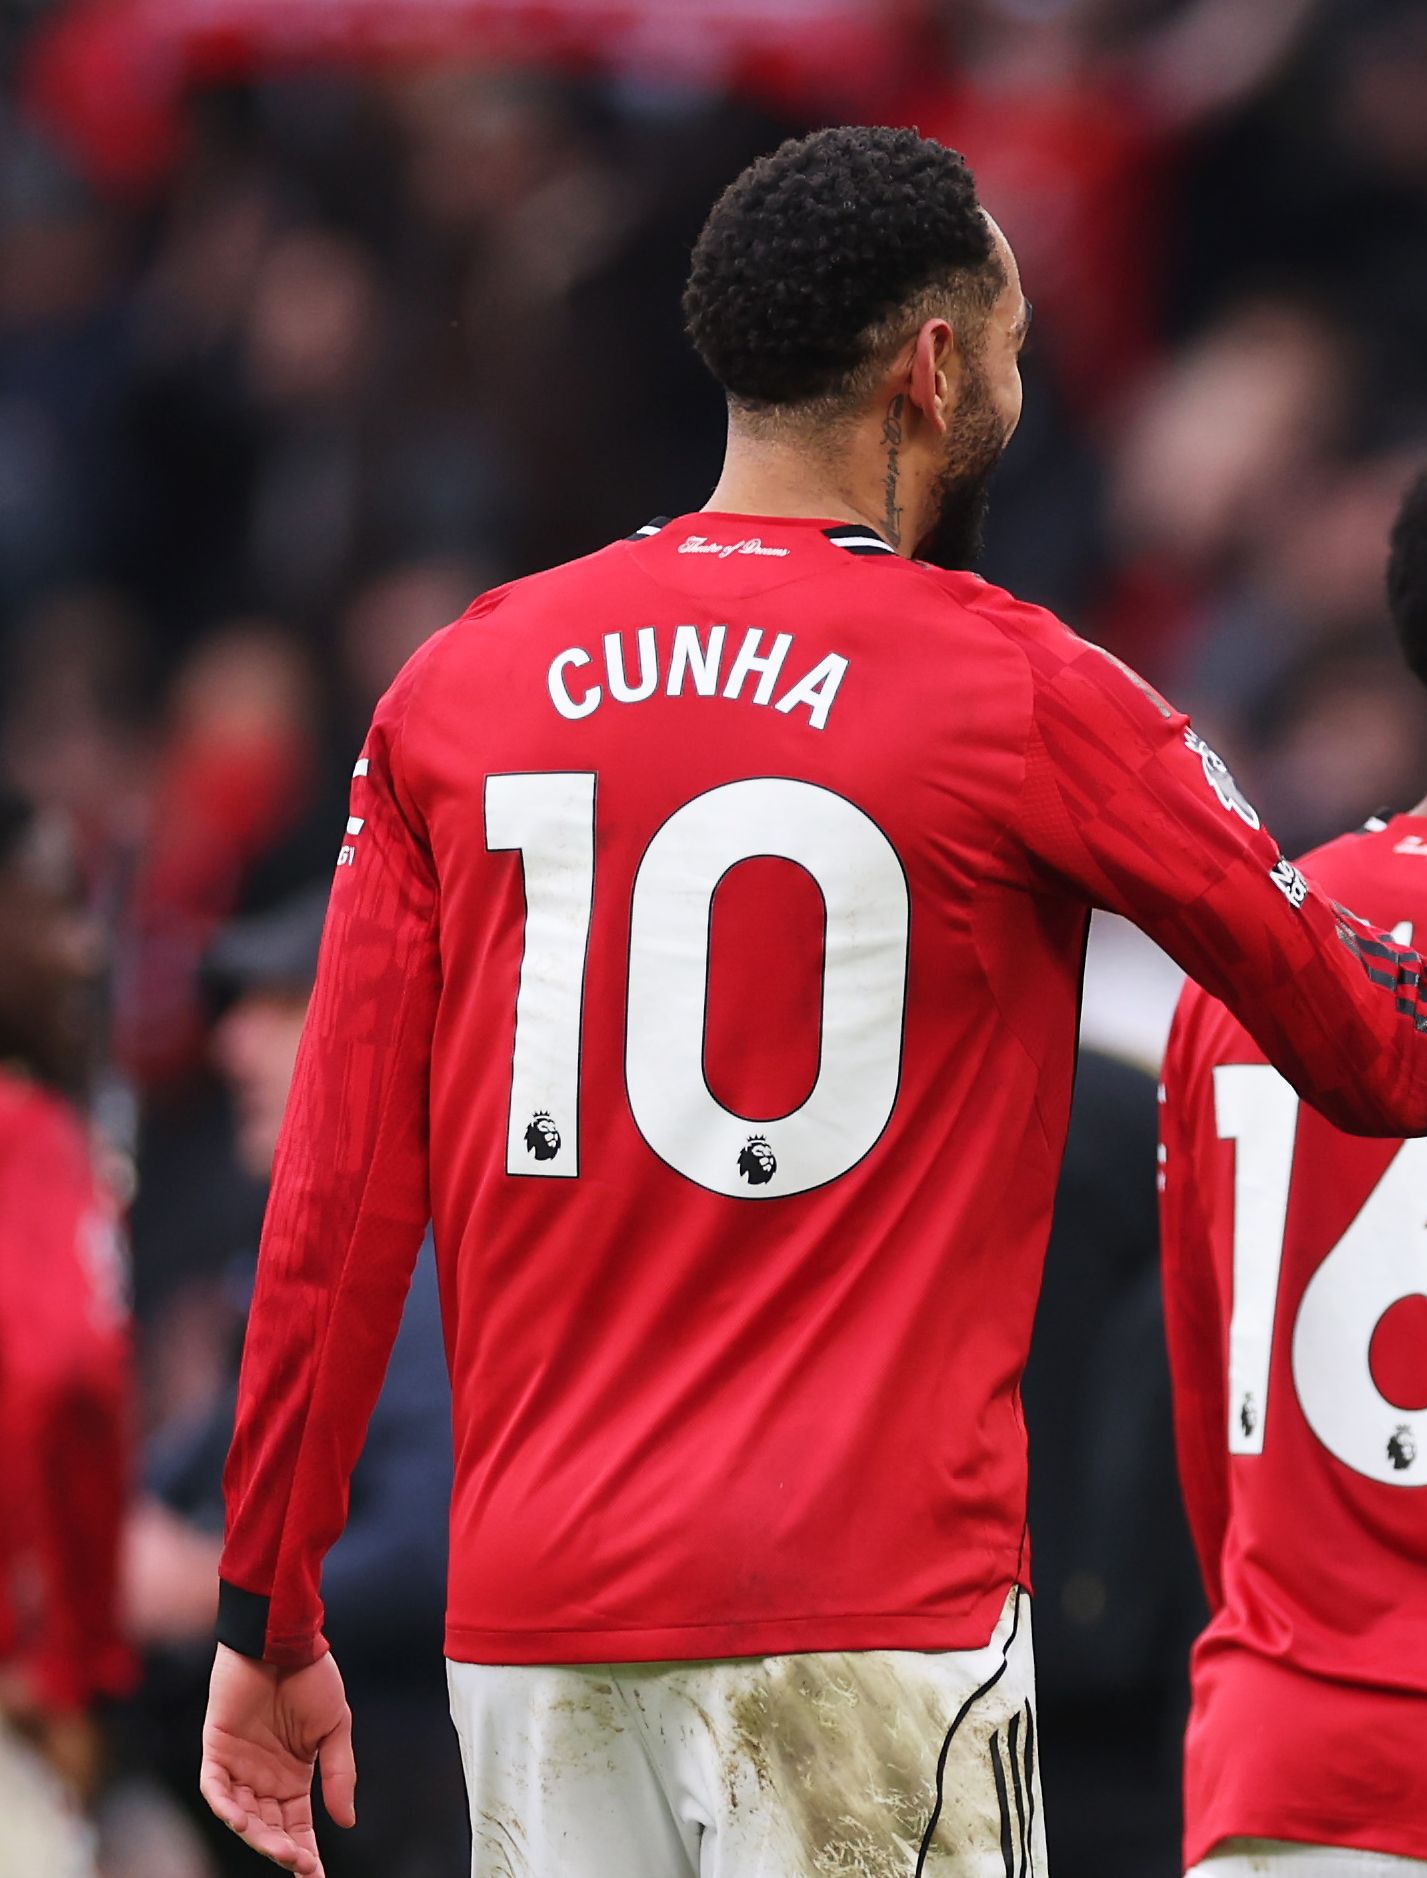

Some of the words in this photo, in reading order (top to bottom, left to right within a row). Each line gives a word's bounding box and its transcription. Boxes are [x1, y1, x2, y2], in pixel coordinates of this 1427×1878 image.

[718, 539, 746, 559] of
[547, 624, 849, 731] CUNHA
[483, 770, 911, 1201] 10
